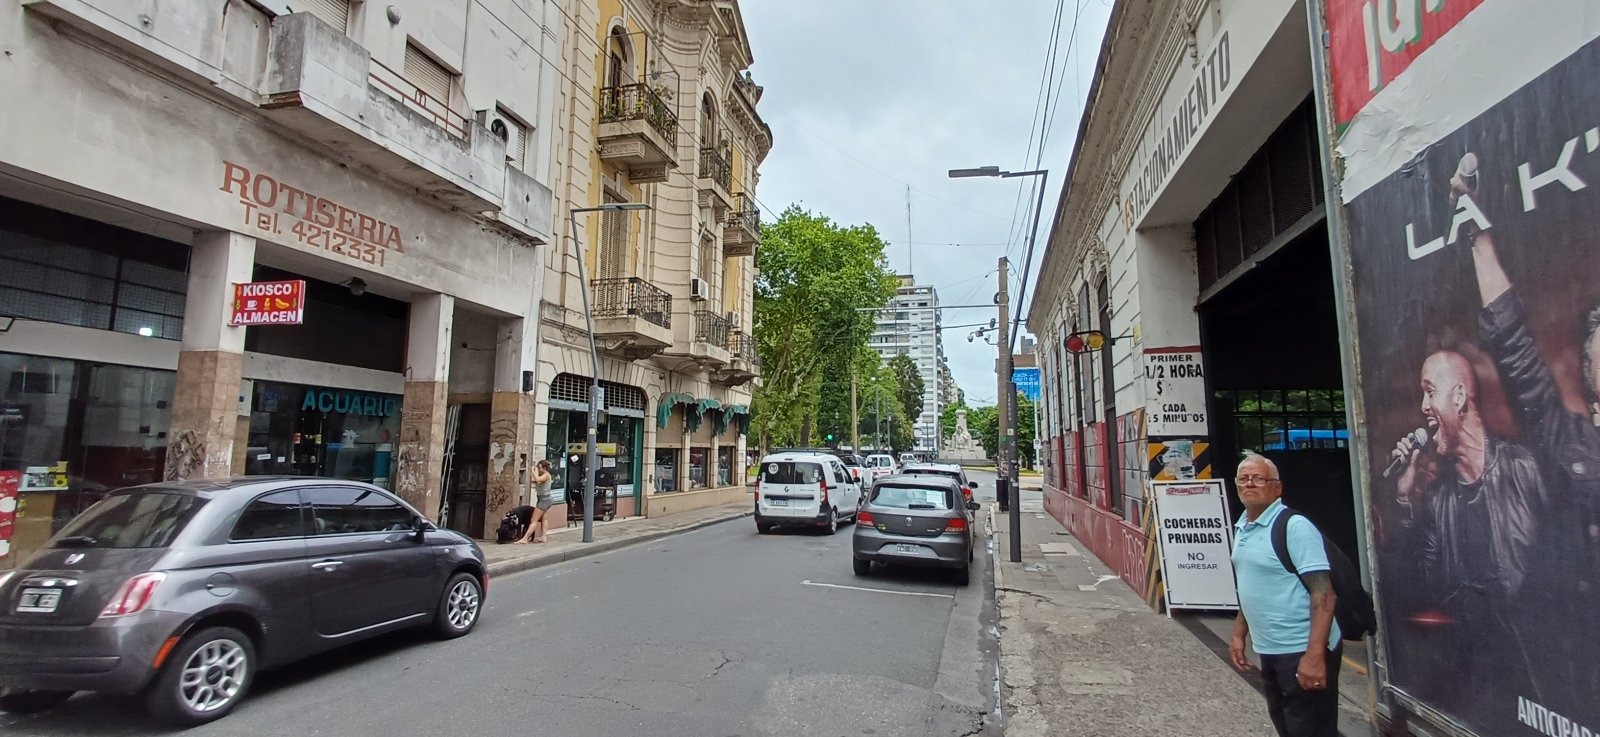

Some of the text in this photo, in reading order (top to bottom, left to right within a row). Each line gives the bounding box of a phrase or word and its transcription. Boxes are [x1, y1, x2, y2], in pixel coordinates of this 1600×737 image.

[1123, 30, 1231, 235] ESTACIONAMIENTO
[219, 160, 404, 254] ROTISERIA
[239, 199, 385, 267] Tel. 4212331
[1405, 193, 1492, 260] LA
[243, 283, 292, 297] KIOSCO
[233, 311, 297, 323] ALMACEN
[1150, 354, 1193, 362] PRIMER
[1145, 363, 1204, 379] 1/2 HORA
[1156, 380, 1163, 396] $
[302, 388, 397, 417] ACUARIO
[1162, 403, 1187, 413] CADA
[1164, 517, 1222, 529] COCHERAS
[1167, 532, 1223, 544] PRIVADAS
[1187, 552, 1205, 561] NO
